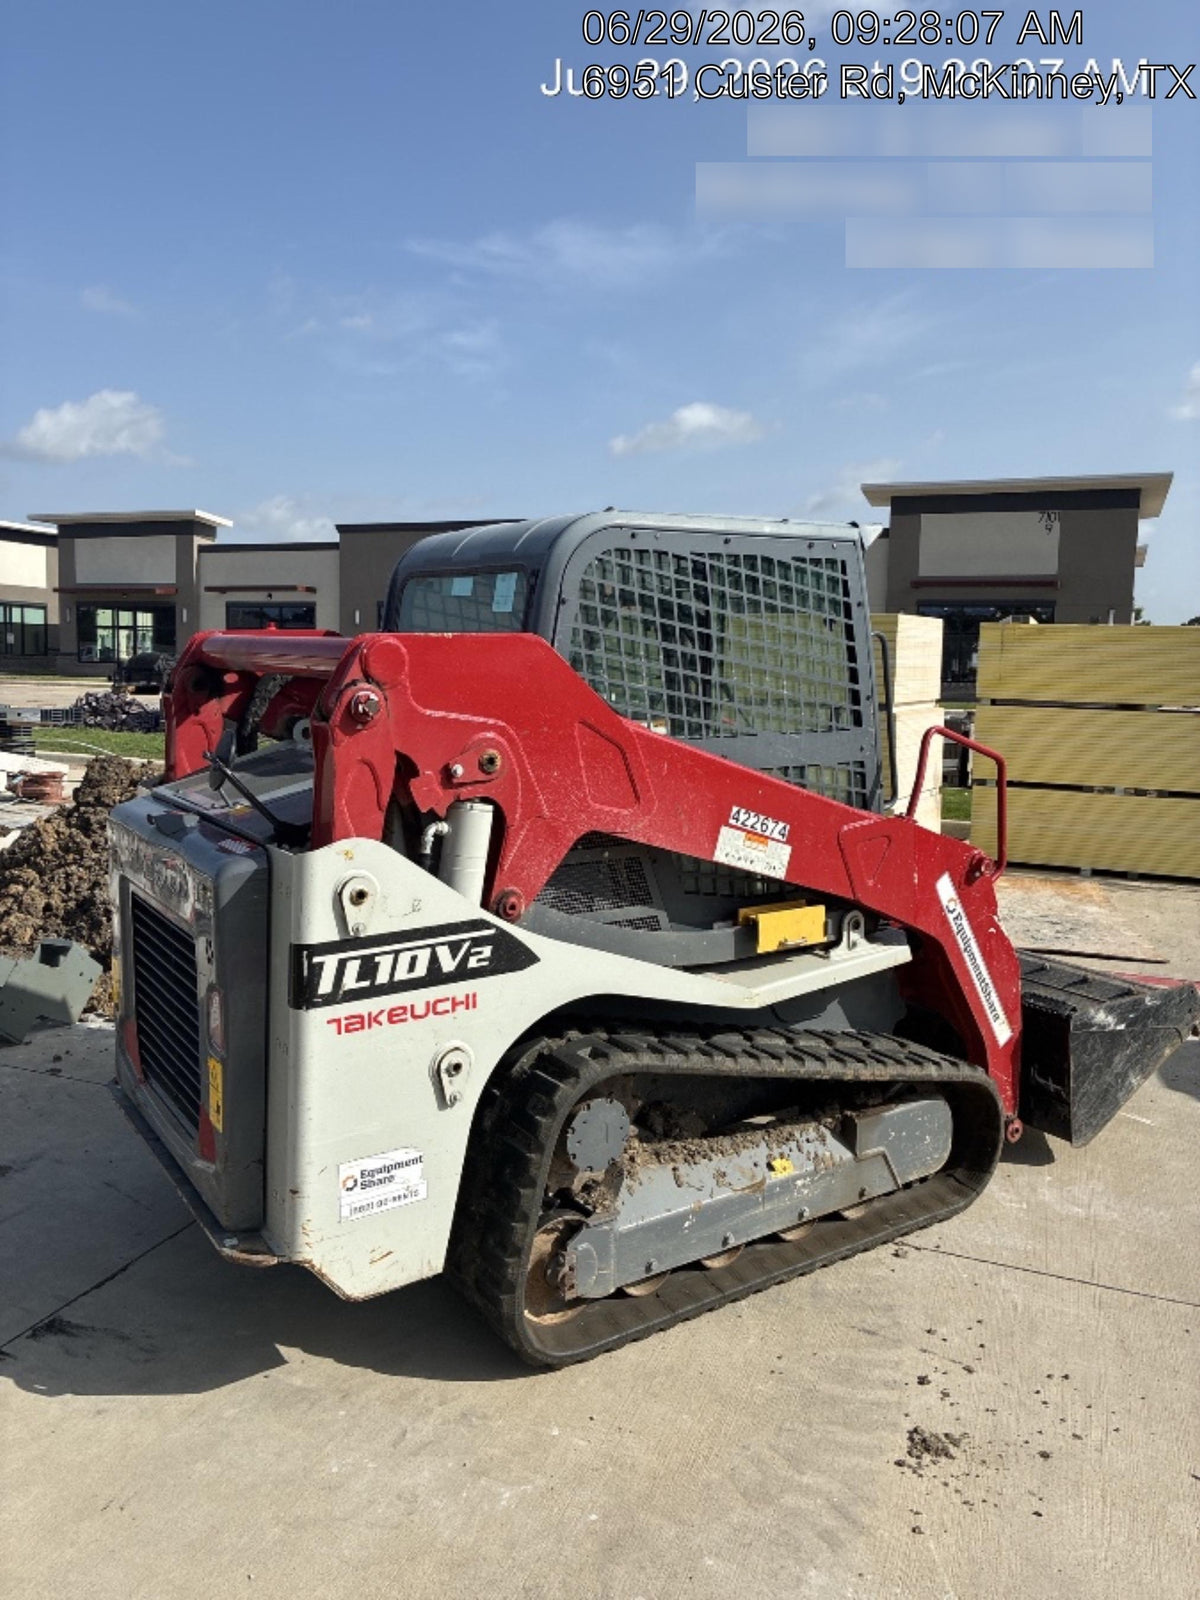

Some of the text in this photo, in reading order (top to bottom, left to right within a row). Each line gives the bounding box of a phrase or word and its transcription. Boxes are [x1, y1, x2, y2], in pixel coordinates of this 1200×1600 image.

[731, 808, 788, 840] 422674
[312, 939, 493, 996] TL10V2
[327, 992, 478, 1035] TAKEUCHI
[360, 1154, 424, 1179] Equipment
[360, 1174, 396, 1190] Share
